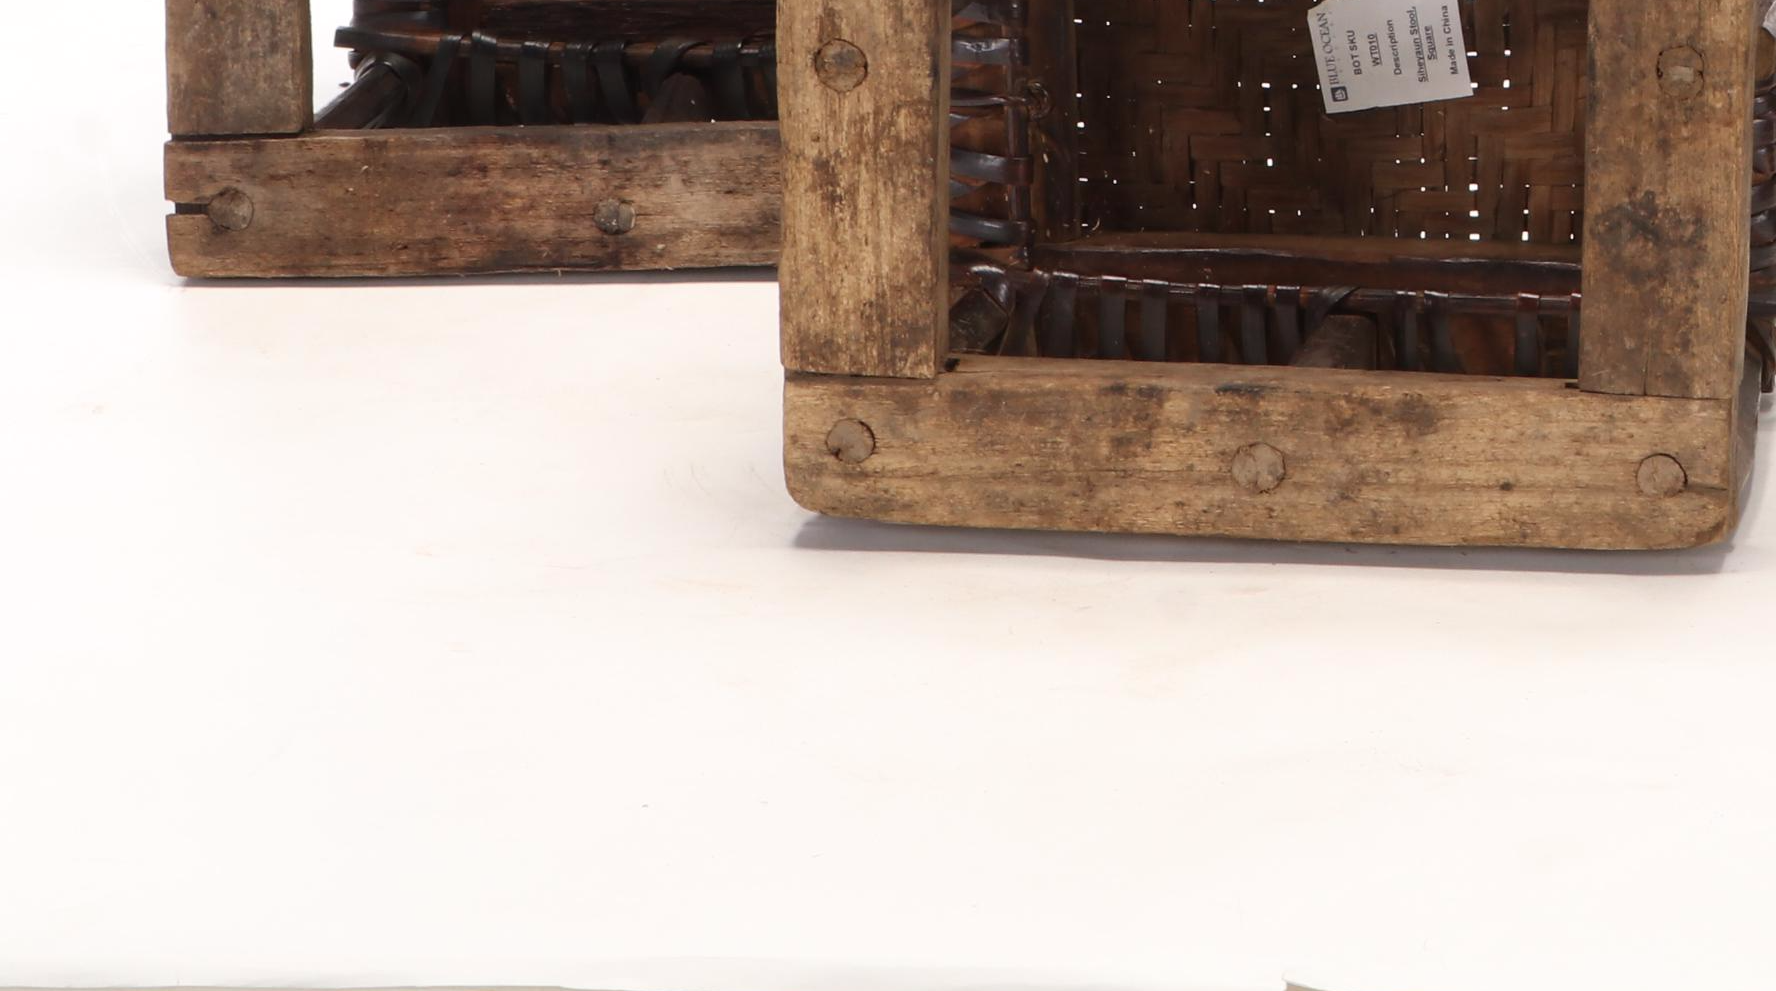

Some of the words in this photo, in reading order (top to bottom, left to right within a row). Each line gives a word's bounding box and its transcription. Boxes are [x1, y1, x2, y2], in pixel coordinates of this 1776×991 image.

[1317, 12, 1333, 54] OCEAN
[1406, 6, 1418, 35] Stool,
[1441, 5, 1451, 34] China
[1346, 30, 1357, 51] SKU
[1367, 34, 1382, 66] WT010
[1386, 19, 1402, 75] Description
[1423, 26, 1437, 60] Square
[1445, 37, 1453, 46] in
[1325, 56, 1339, 84] BLUE
[1351, 54, 1362, 75] BOT
[1412, 37, 1428, 82] Siheyaun
[1448, 49, 1458, 74] Made
